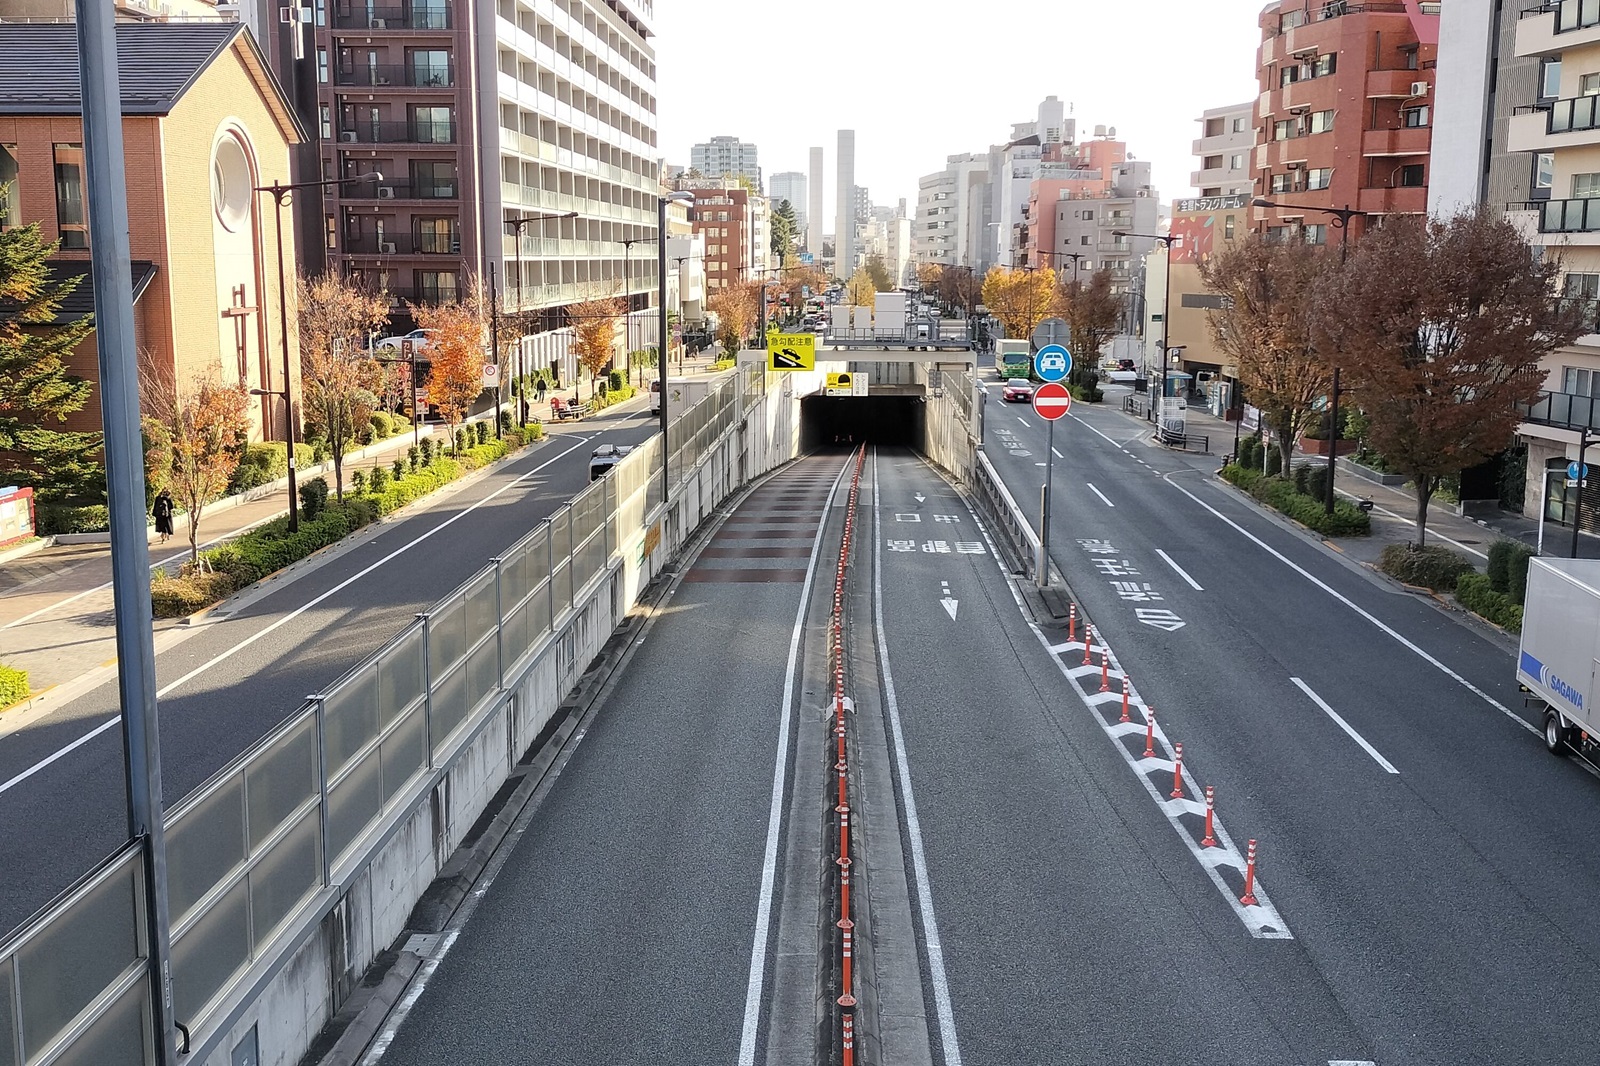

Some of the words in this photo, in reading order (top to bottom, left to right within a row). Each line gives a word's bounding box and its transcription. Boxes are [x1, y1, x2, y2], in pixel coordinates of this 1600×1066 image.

[770, 337, 812, 346] 急勾配注意
[895, 513, 960, 524] 出口
[1075, 538, 1186, 631] 合流注意
[1550, 674, 1583, 710] SAGAWA
